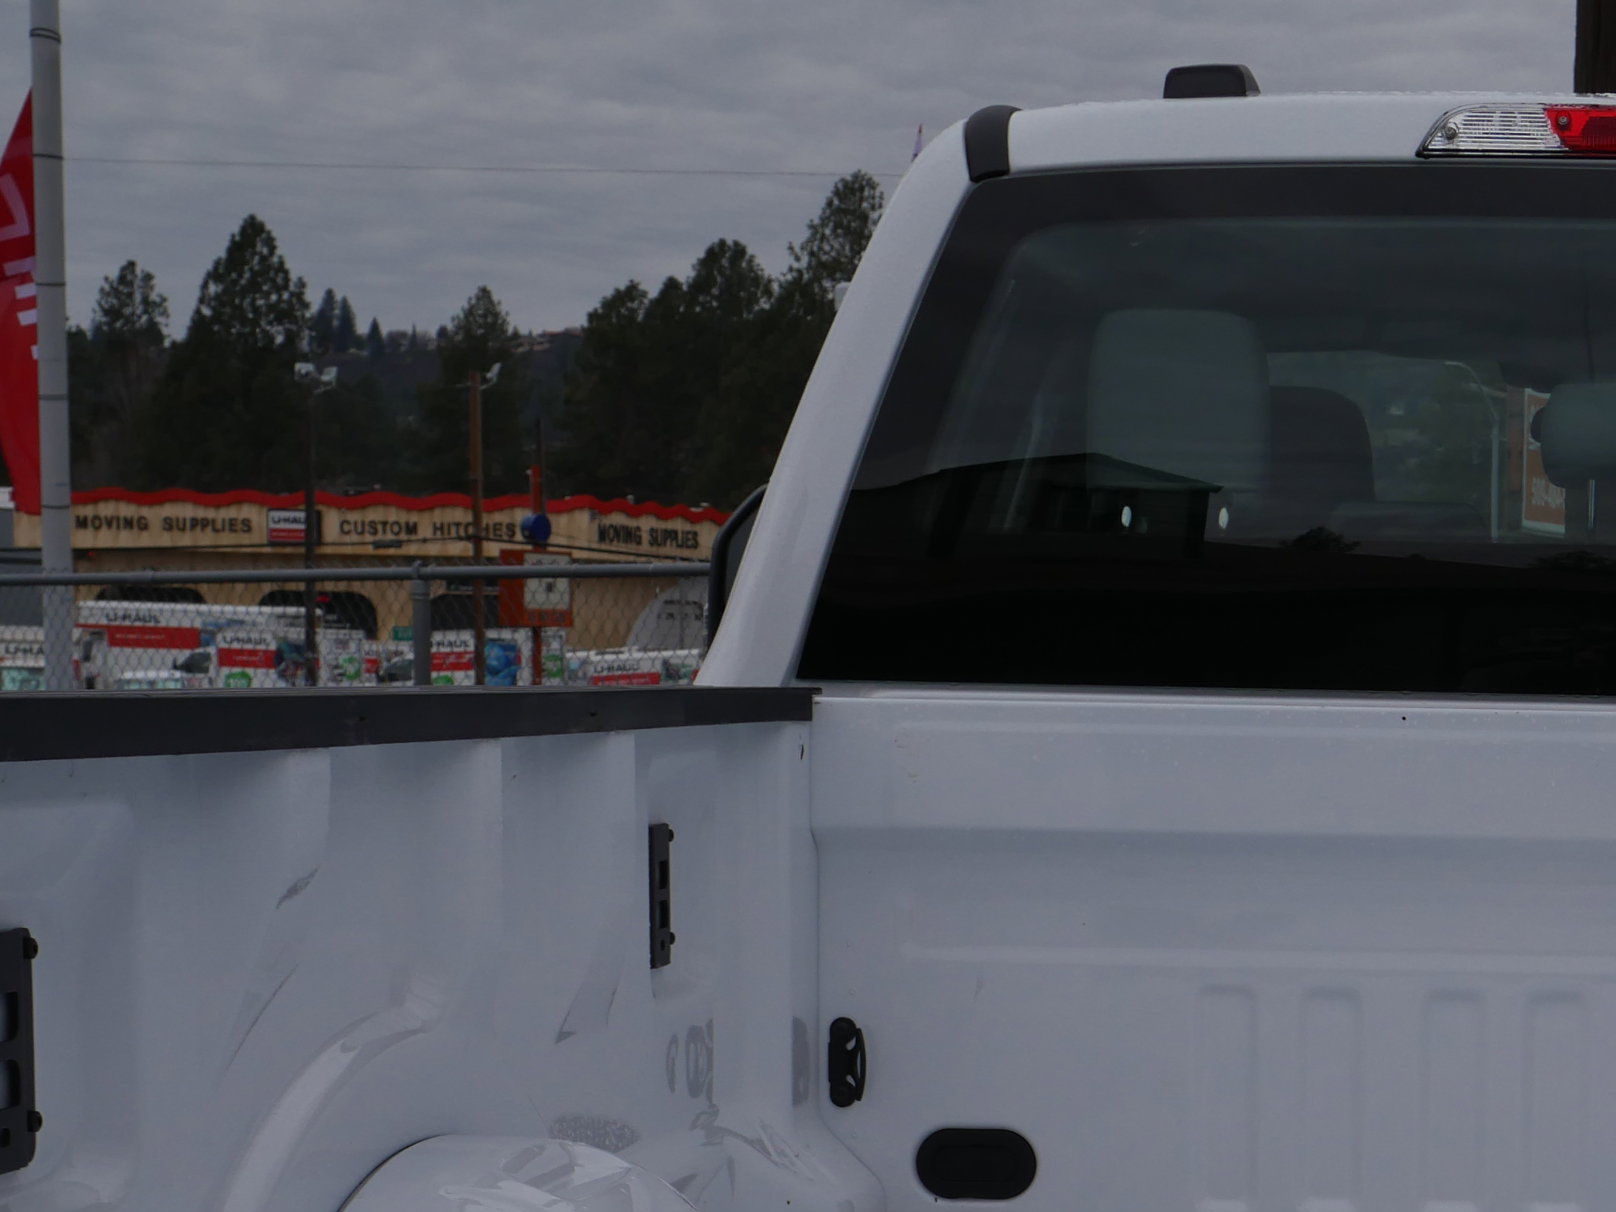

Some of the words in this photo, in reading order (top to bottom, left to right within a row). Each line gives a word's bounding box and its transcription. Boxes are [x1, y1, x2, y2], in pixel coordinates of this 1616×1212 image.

[75, 515, 150, 532] MOVING
[162, 516, 253, 533] SUPPLIES
[339, 520, 418, 536] CUSTOM
[432, 522, 517, 538] HITCHES
[598, 522, 643, 546] MOVING
[649, 527, 699, 549] SUPPLIES
